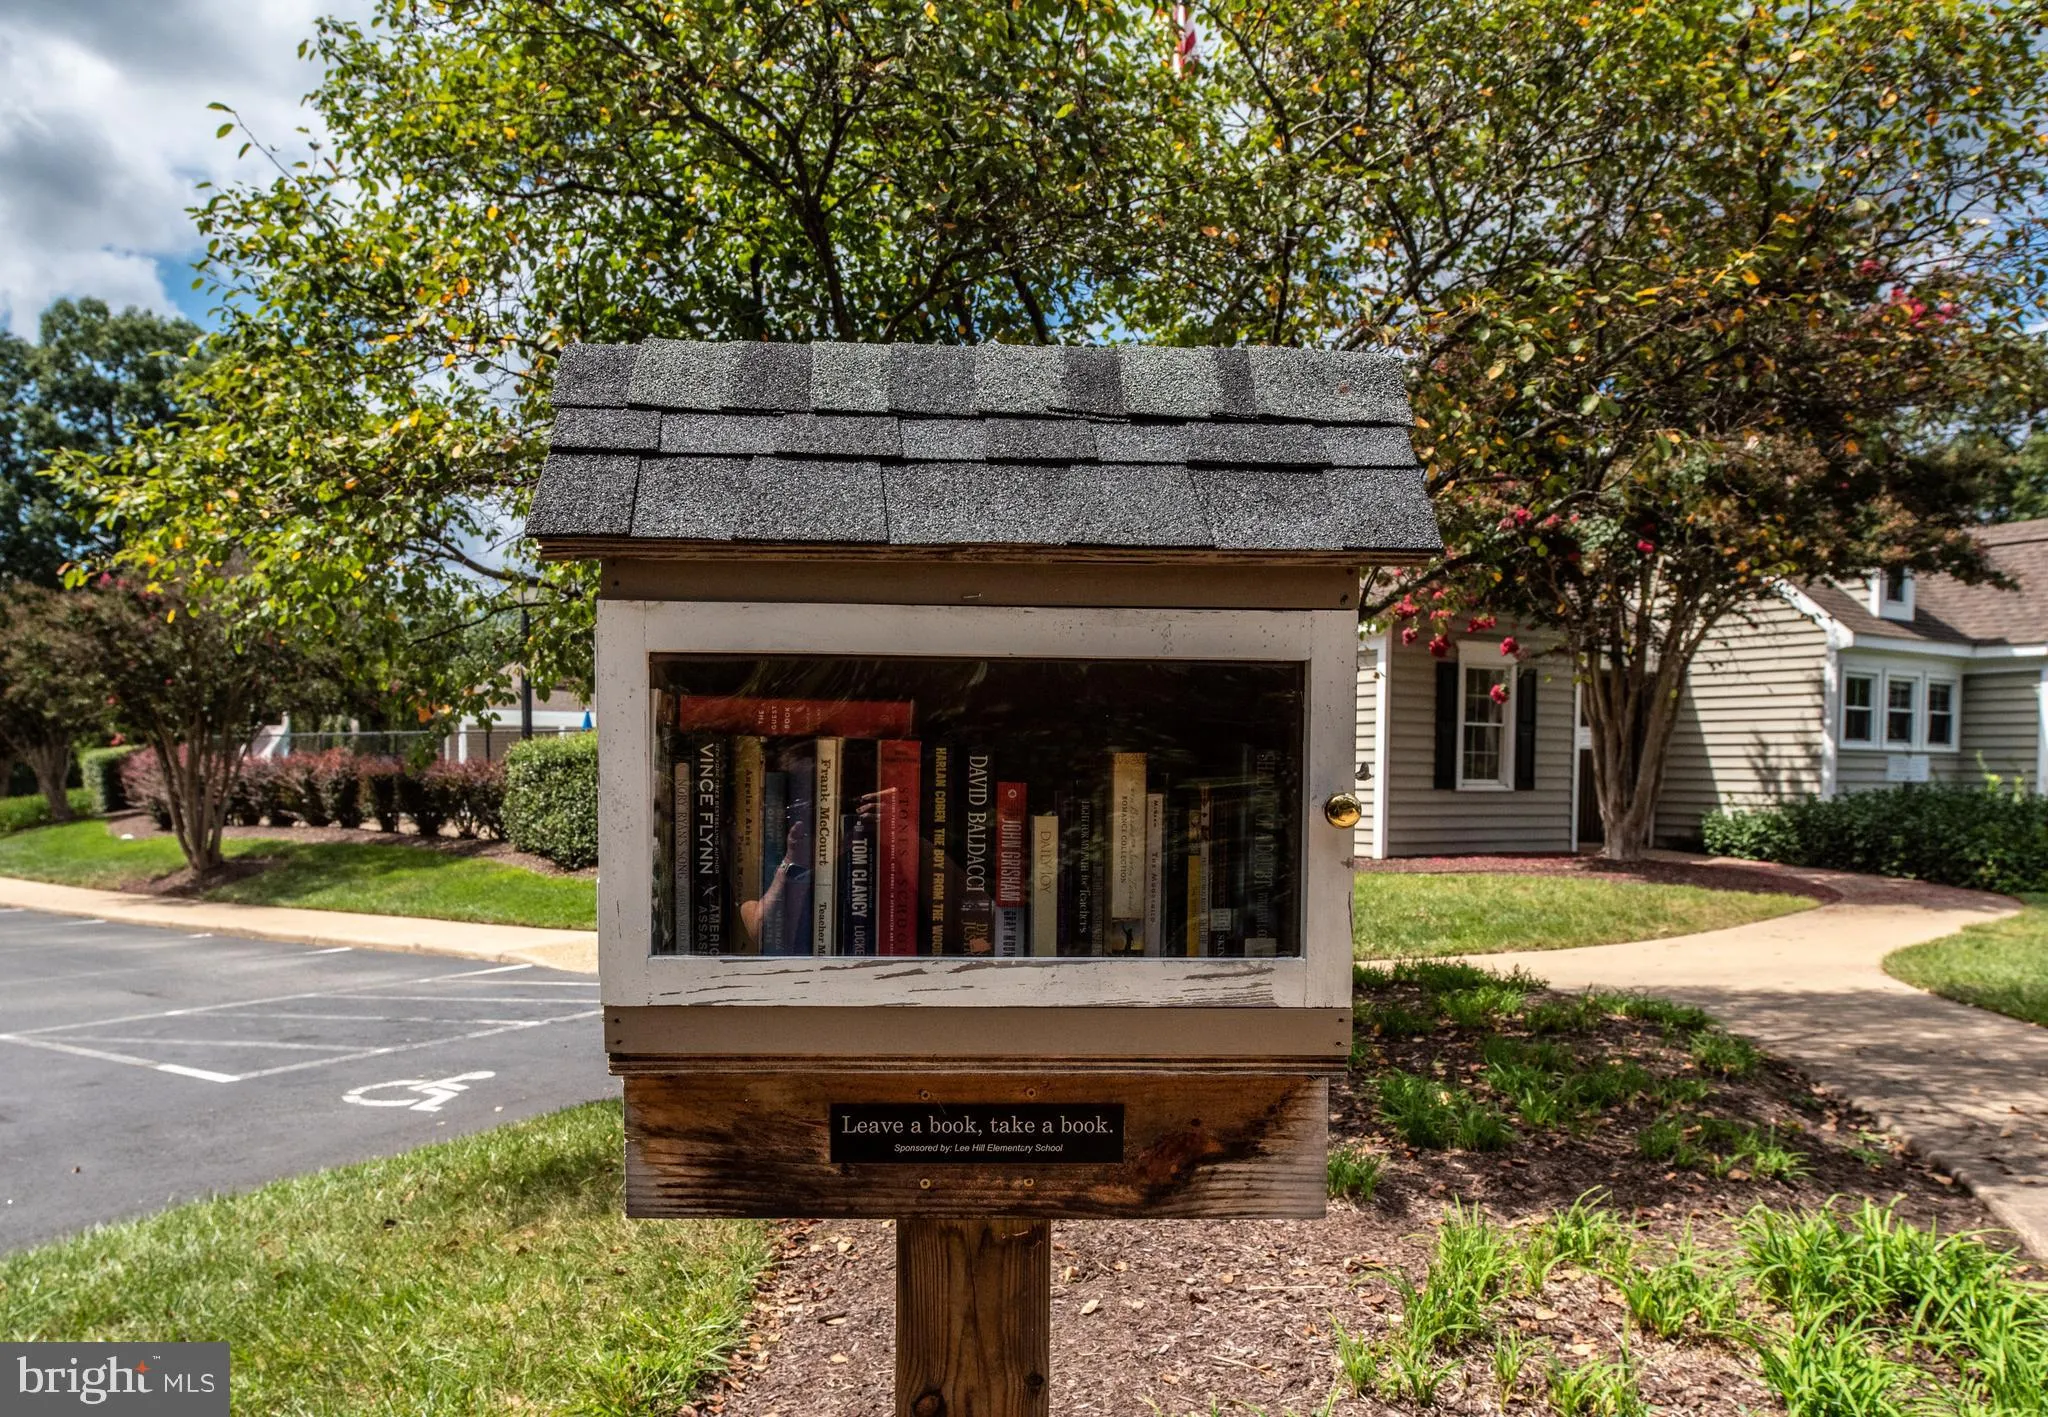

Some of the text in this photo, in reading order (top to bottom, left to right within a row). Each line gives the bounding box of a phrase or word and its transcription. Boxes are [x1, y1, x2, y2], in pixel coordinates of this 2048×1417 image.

[935, 748, 947, 787] HARLAN
[968, 755, 988, 806] DAVID
[677, 778, 689, 880] NORY RYAN'S SONG
[699, 743, 714, 874] VINCE FLYNN
[818, 759, 832, 866] Frank McCourt
[934, 791, 947, 823] COBEN
[933, 849, 945, 869] BOY
[934, 828, 946, 846] THE
[966, 811, 987, 892] BALDACCI
[1120, 795, 1129, 884] ROMANCE COLLECTION
[851, 837, 868, 918] TOM CLANCY
[1000, 818, 1022, 901] JOHN GRISHAM
[1039, 831, 1052, 895] DAILY JOY
[933, 872, 945, 901] FROM
[818, 902, 827, 943] Teacher
[932, 903, 944, 921] THE
[1003, 911, 1017, 932] GRAY
[1079, 888, 1091, 936] Teachers
[841, 1115, 1114, 1136] Leave a book, take a book.
[894, 1143, 939, 1153] Sponsored
[940, 1144, 952, 1153] by:
[954, 1144, 970, 1152] Lee
[972, 1143, 985, 1152] Hill
[1035, 1143, 1063, 1152] School
